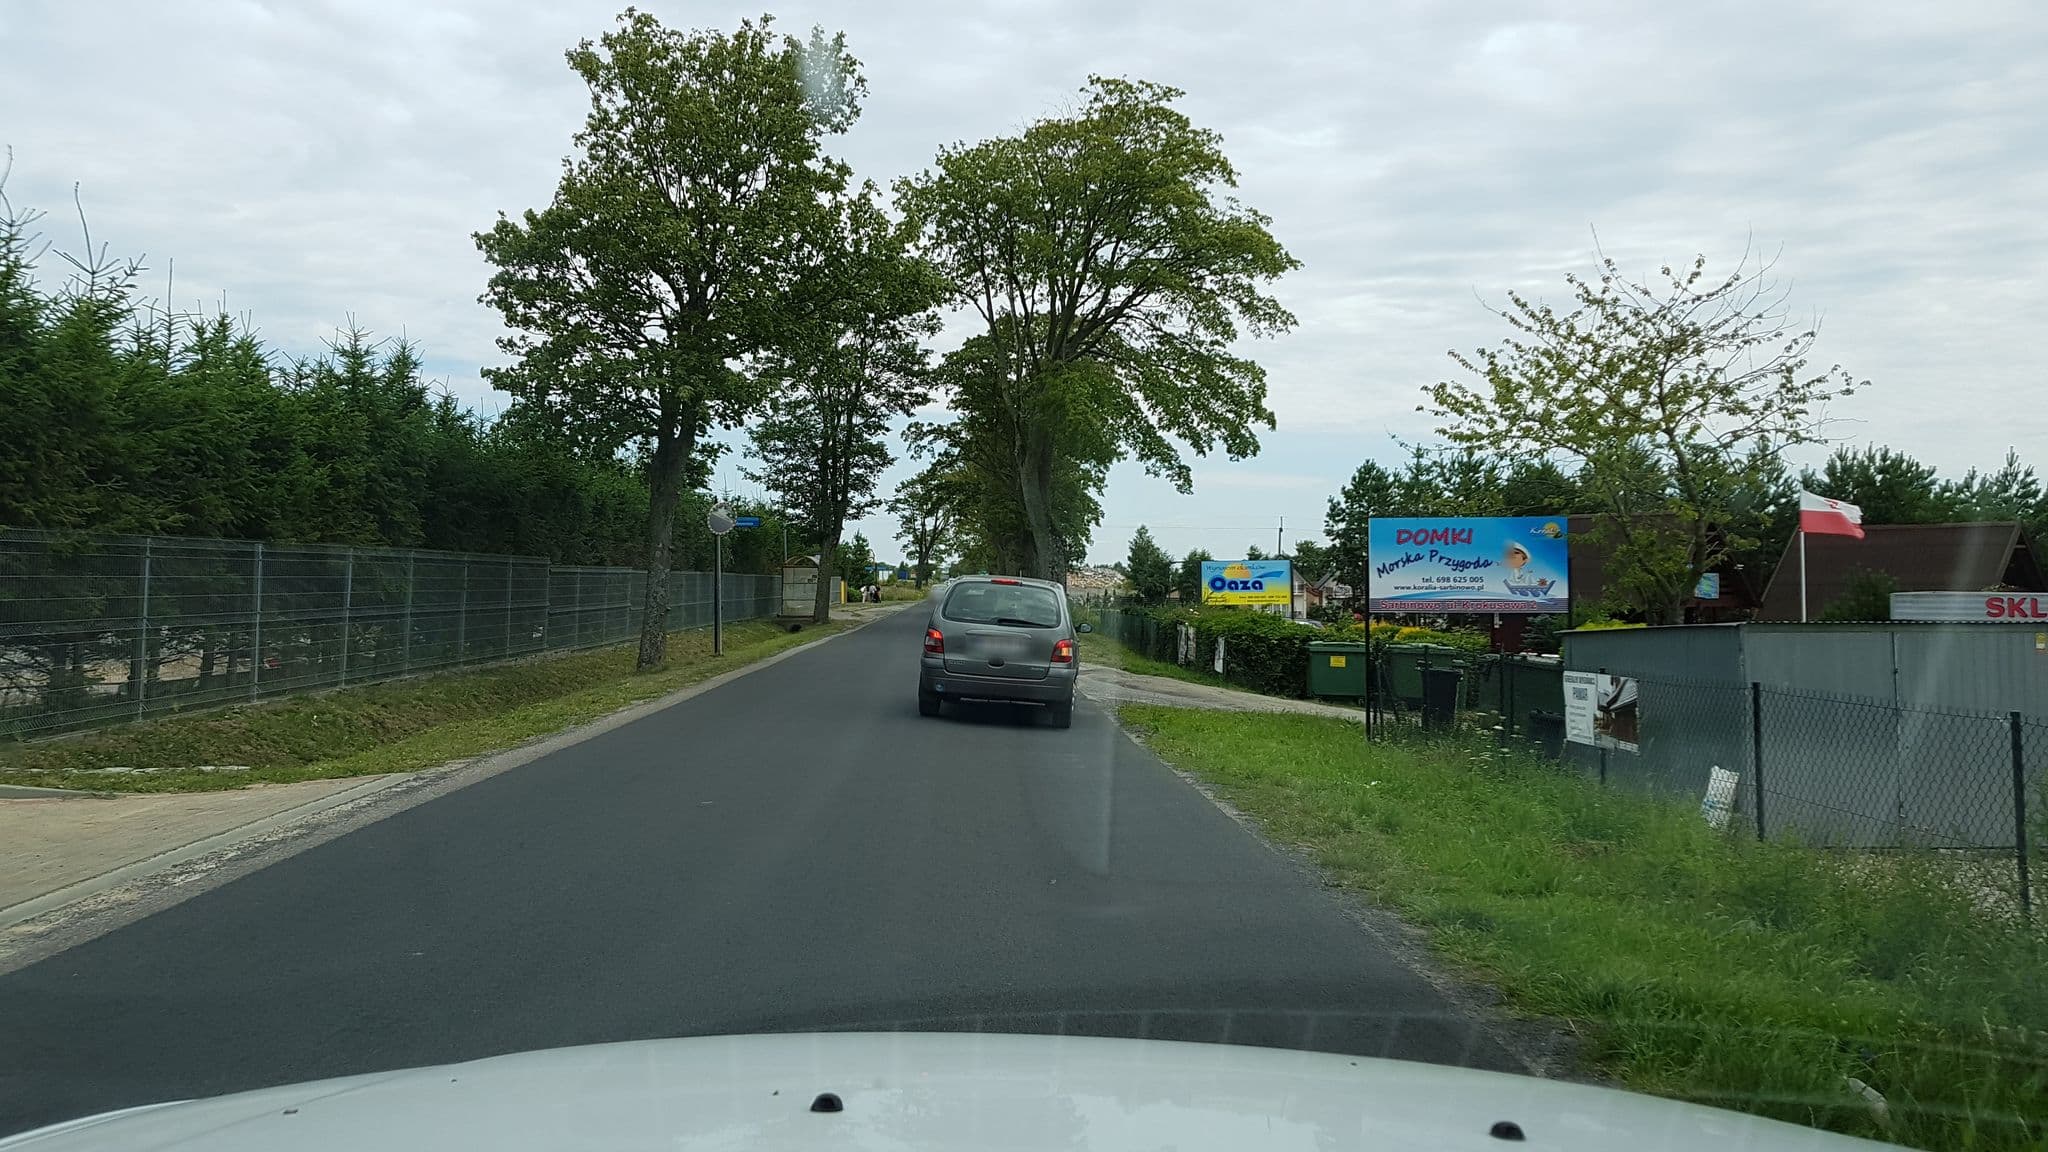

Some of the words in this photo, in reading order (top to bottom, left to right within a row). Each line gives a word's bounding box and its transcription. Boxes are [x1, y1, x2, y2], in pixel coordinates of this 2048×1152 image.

[1396, 527, 1474, 546] DOMKI
[1376, 552, 1425, 578] Morska
[1429, 549, 1493, 572] Przygoda
[1209, 577, 1264, 591] Oaza
[1985, 597, 2048, 618] SKL
